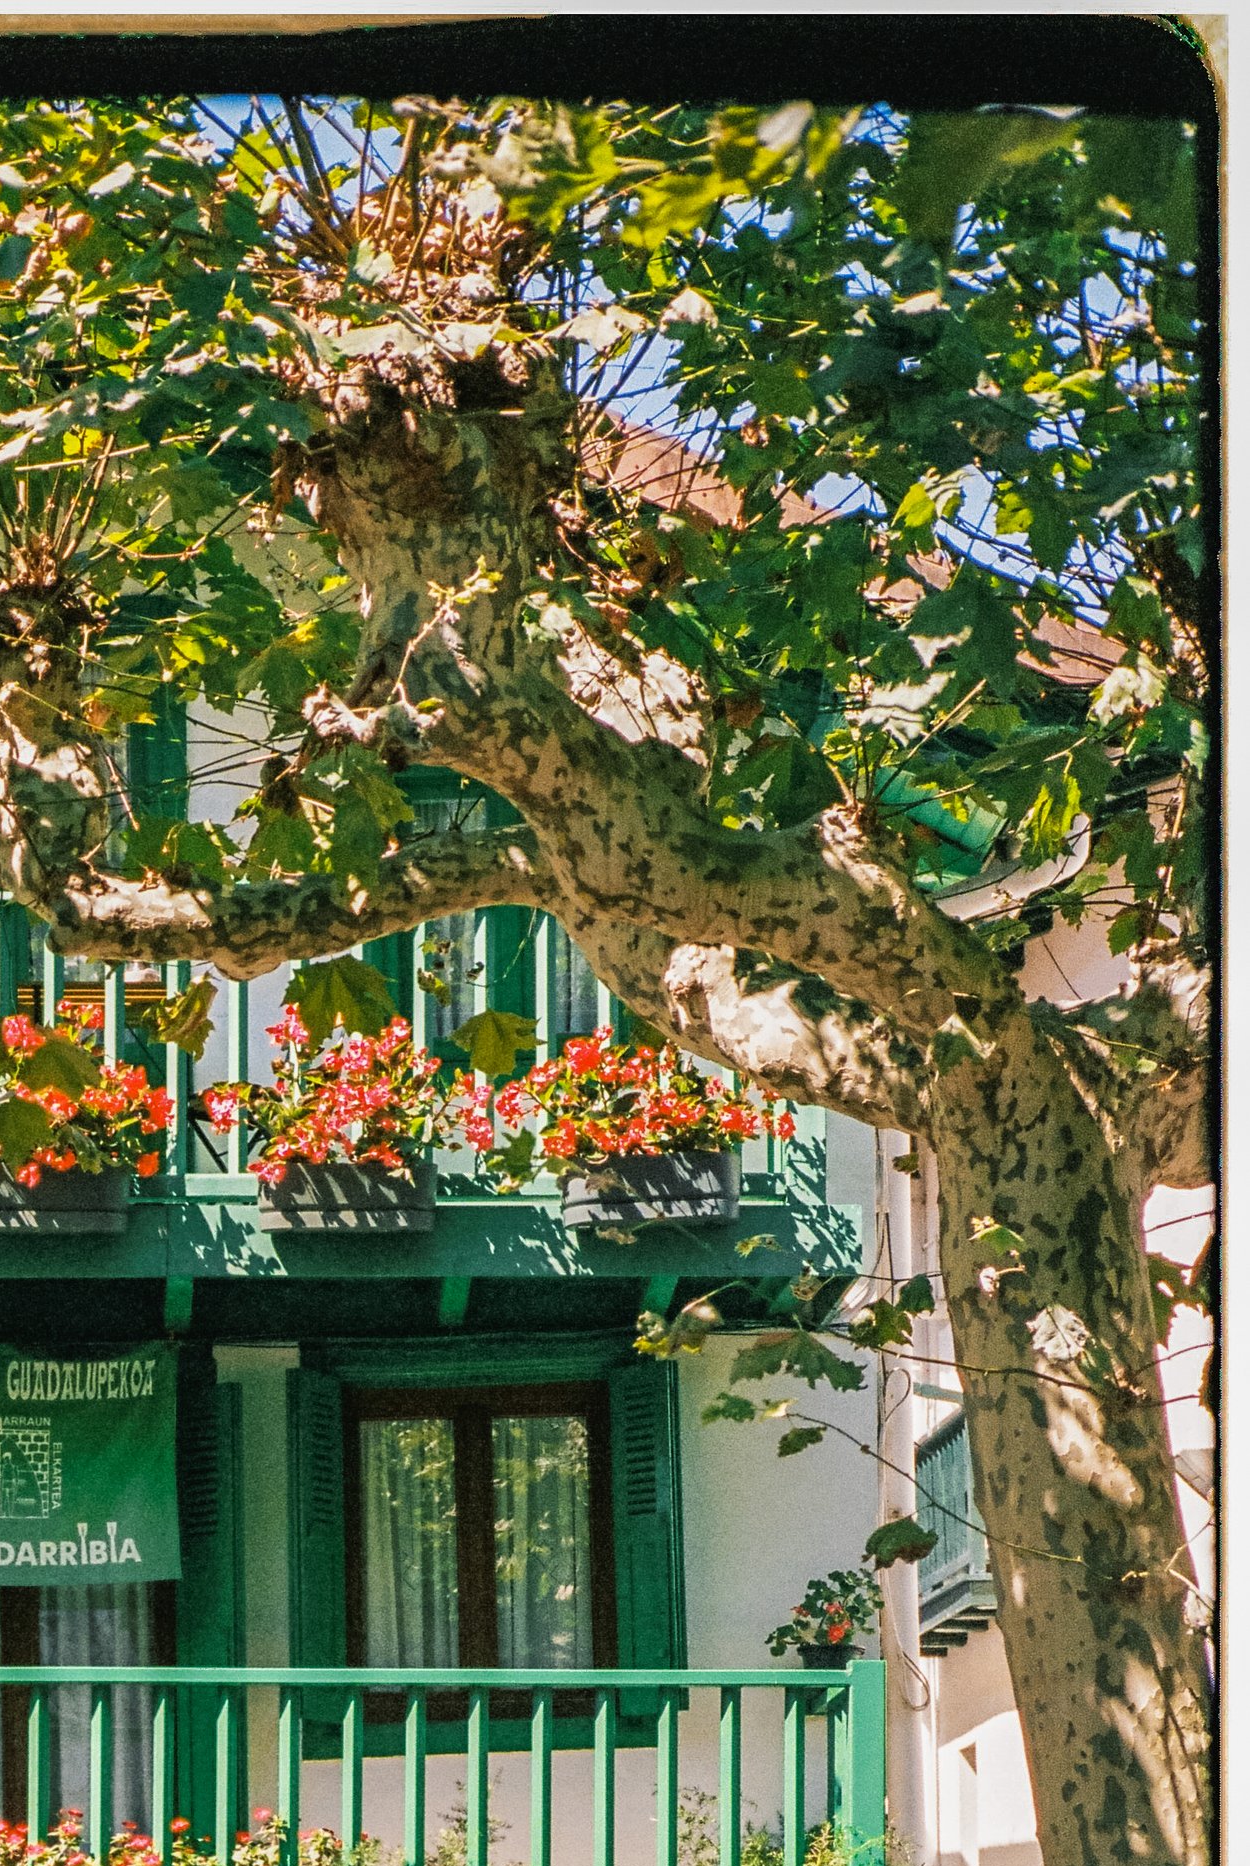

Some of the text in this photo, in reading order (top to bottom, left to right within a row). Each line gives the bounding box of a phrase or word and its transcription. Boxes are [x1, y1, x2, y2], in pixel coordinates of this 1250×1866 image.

[6, 1359, 156, 1401] GUADALUPEKOA
[3, 1416, 51, 1427] ARRAUN
[52, 1442, 63, 1510] ELKARTEA
